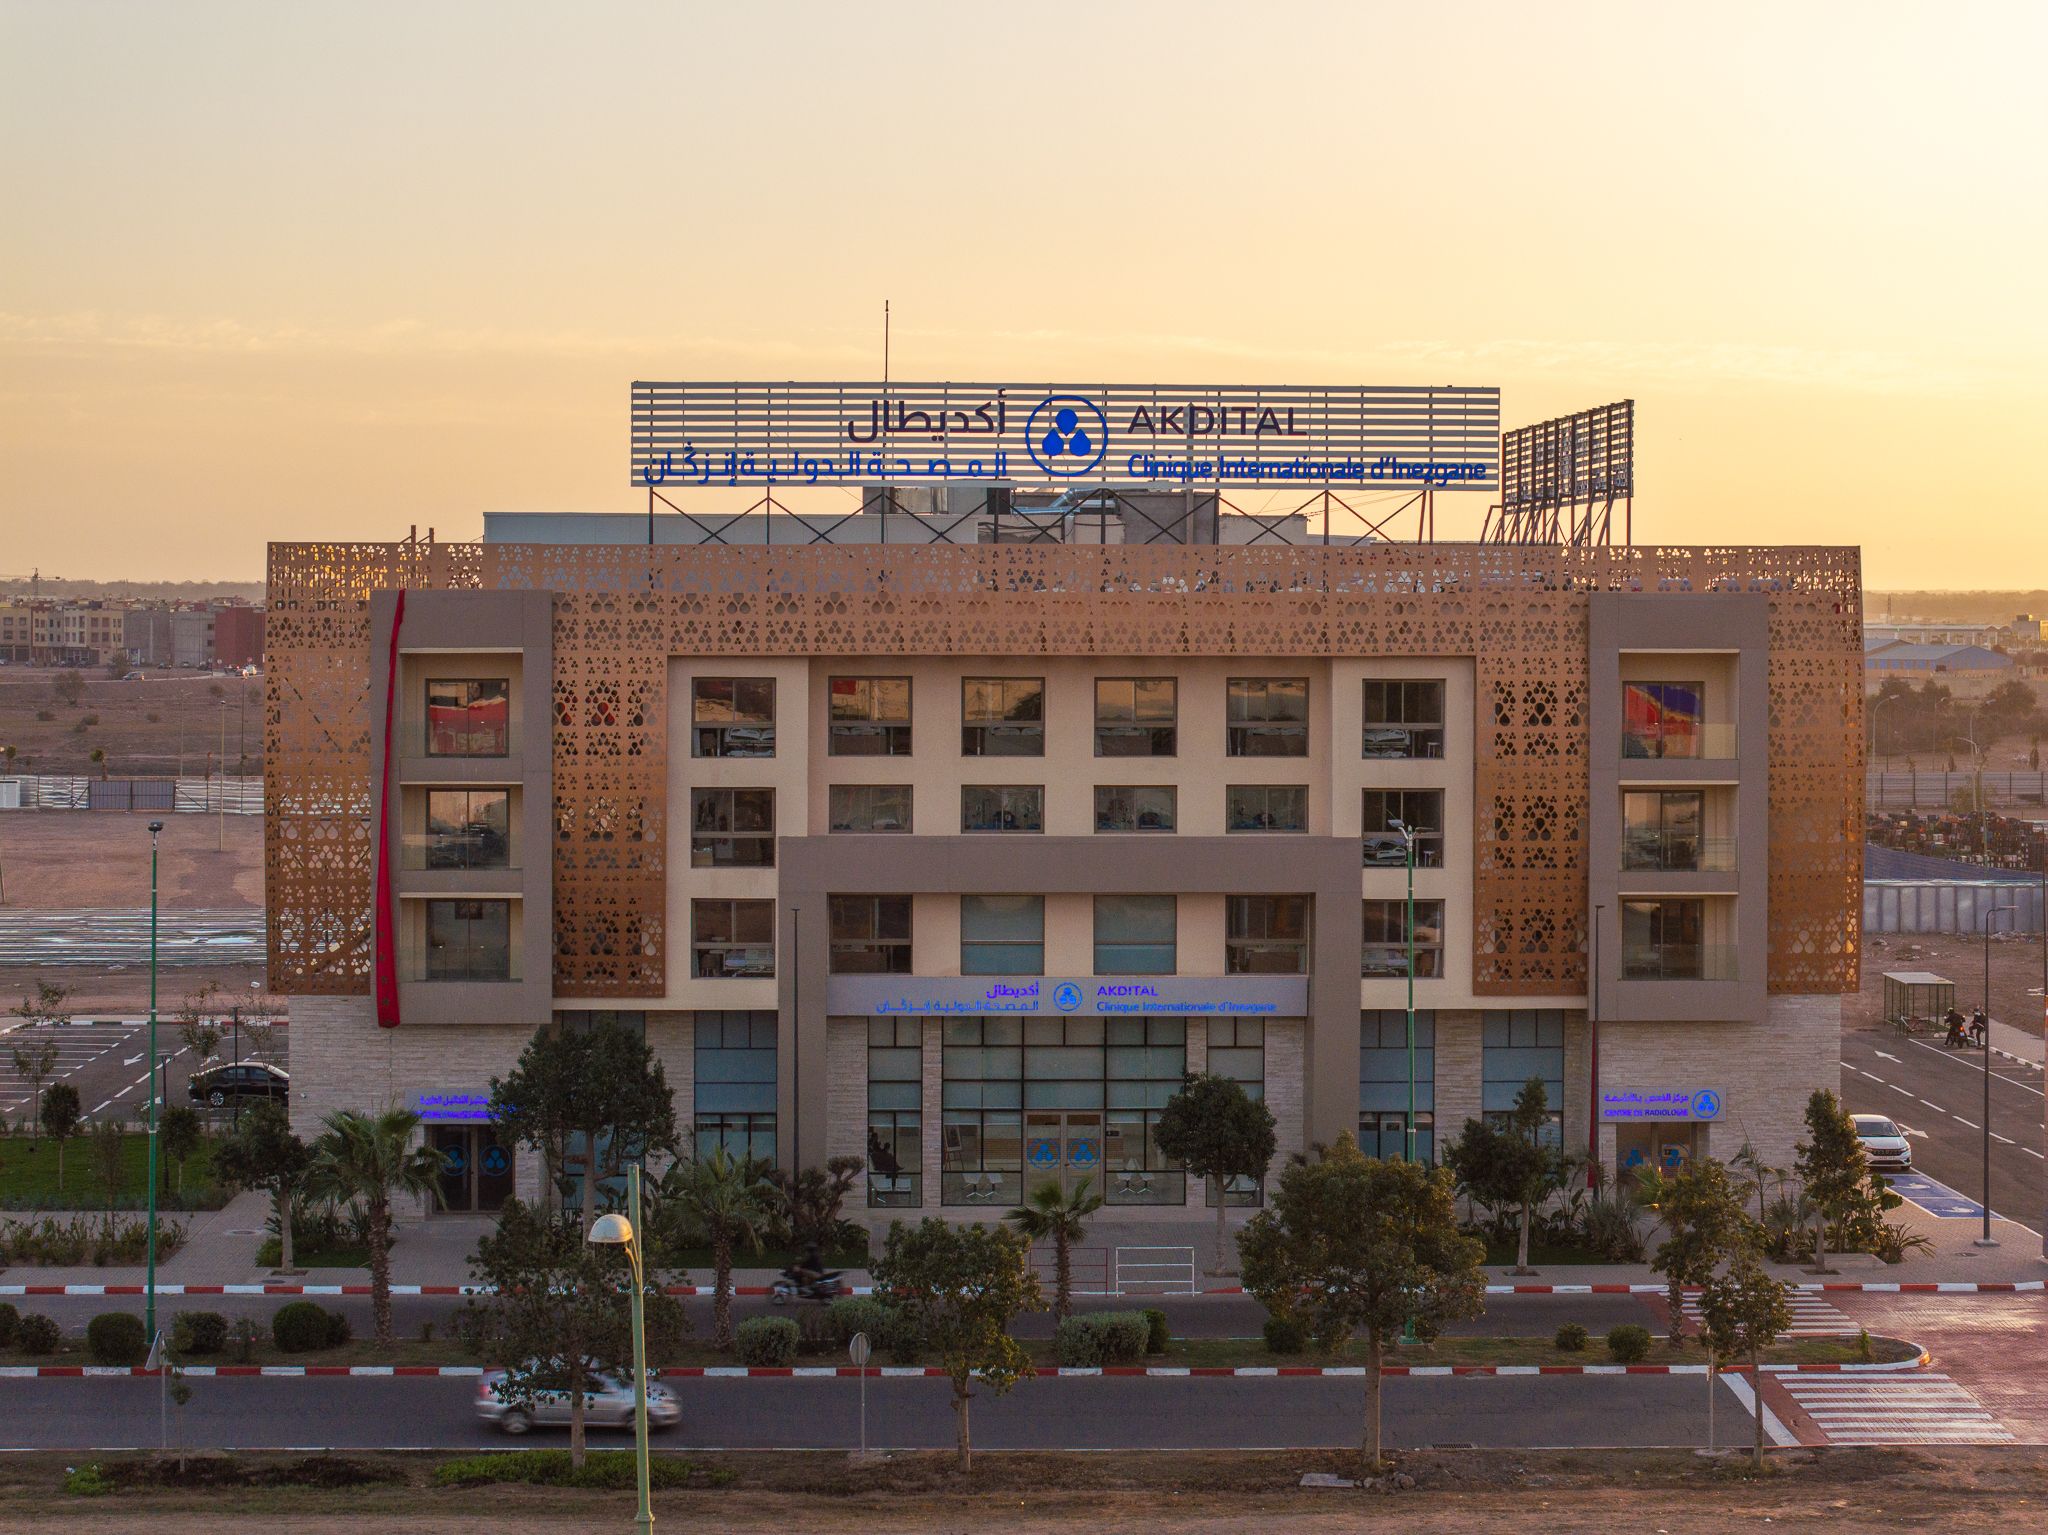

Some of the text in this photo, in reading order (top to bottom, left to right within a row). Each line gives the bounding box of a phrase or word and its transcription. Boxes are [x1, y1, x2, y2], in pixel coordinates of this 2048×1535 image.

[848, 388, 1007, 443] أكديطال
[1127, 405, 1308, 436] AKDITAL
[740, 451, 861, 484] الدولية
[867, 451, 1007, 477] المصحة
[1127, 453, 1213, 484] Clinique
[1219, 455, 1365, 479] Internationale
[985, 980, 1039, 999] أكديطال
[1097, 985, 1159, 997] AKDITAL
[983, 1000, 1039, 1011] المصحة
[1096, 1001, 1140, 1013] Clinique
[1142, 1001, 1217, 1012] Internationale
